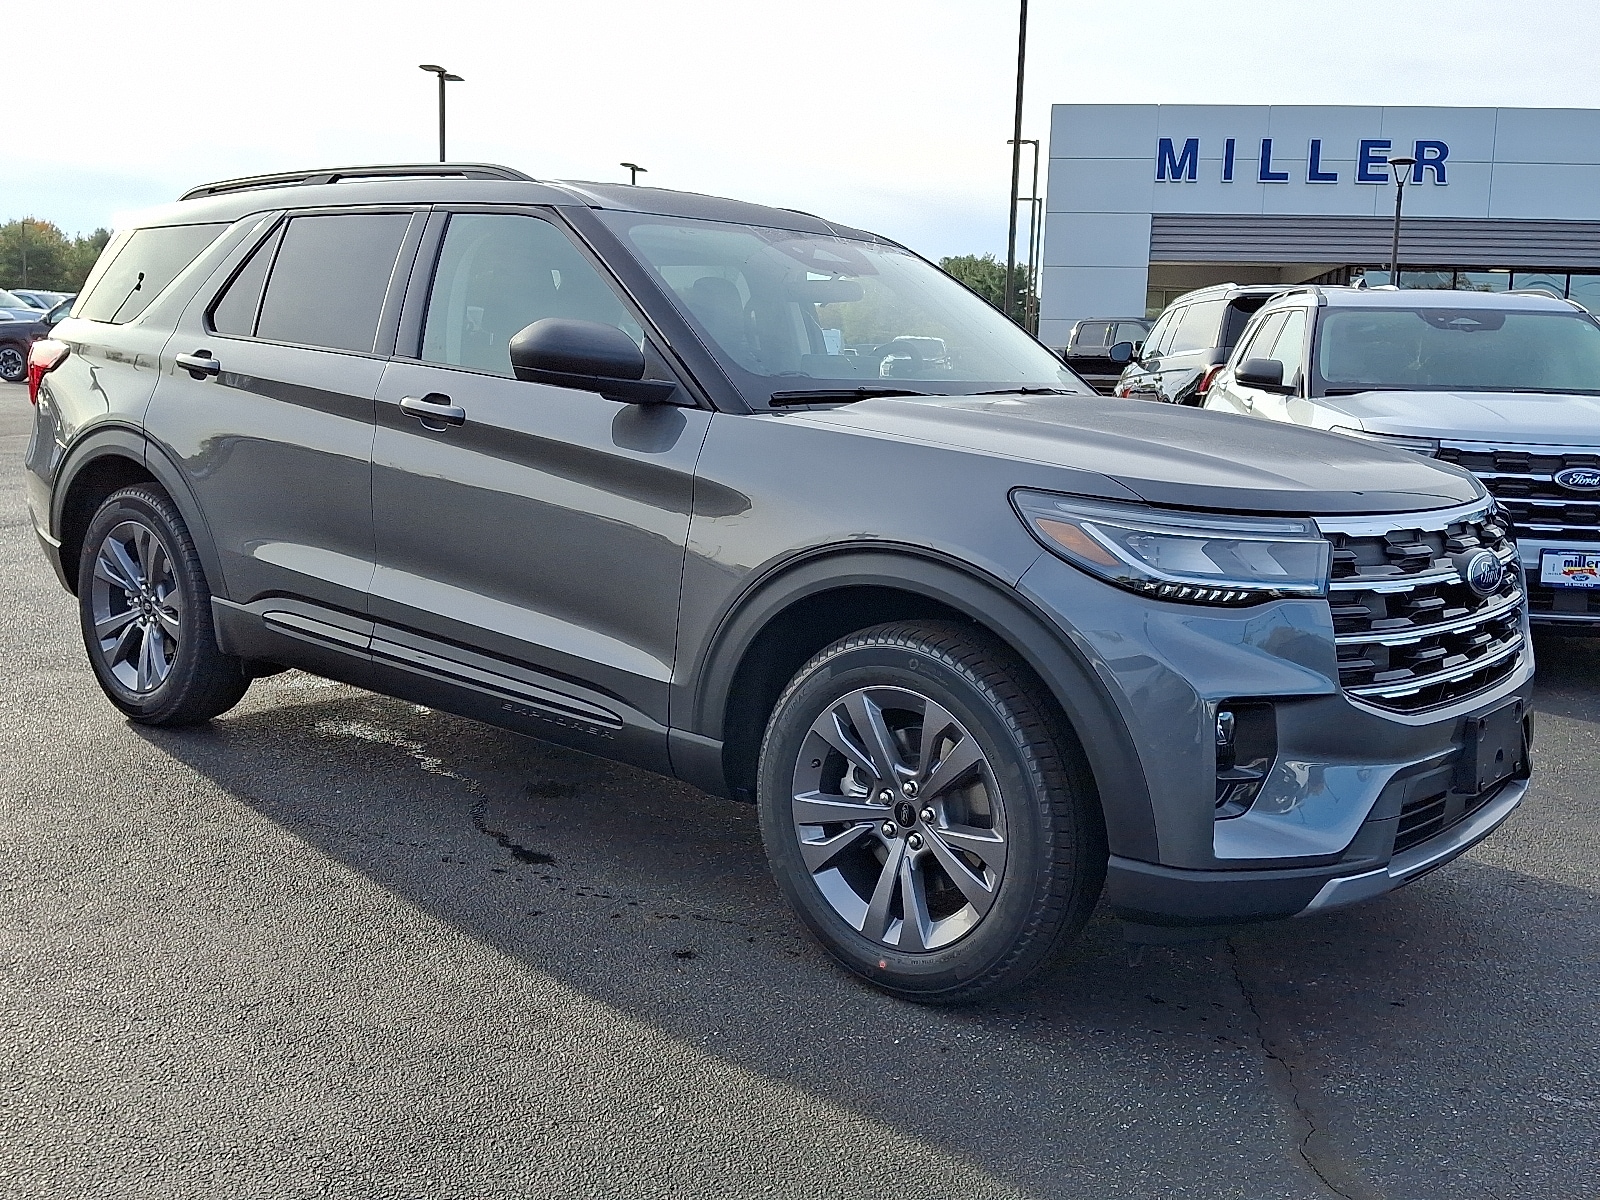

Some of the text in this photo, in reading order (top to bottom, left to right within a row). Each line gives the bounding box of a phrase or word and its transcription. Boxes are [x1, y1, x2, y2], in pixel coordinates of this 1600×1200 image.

[1155, 137, 1450, 185] MILLER
[1569, 472, 1600, 486] Ford
[1563, 556, 1600, 569] miller
